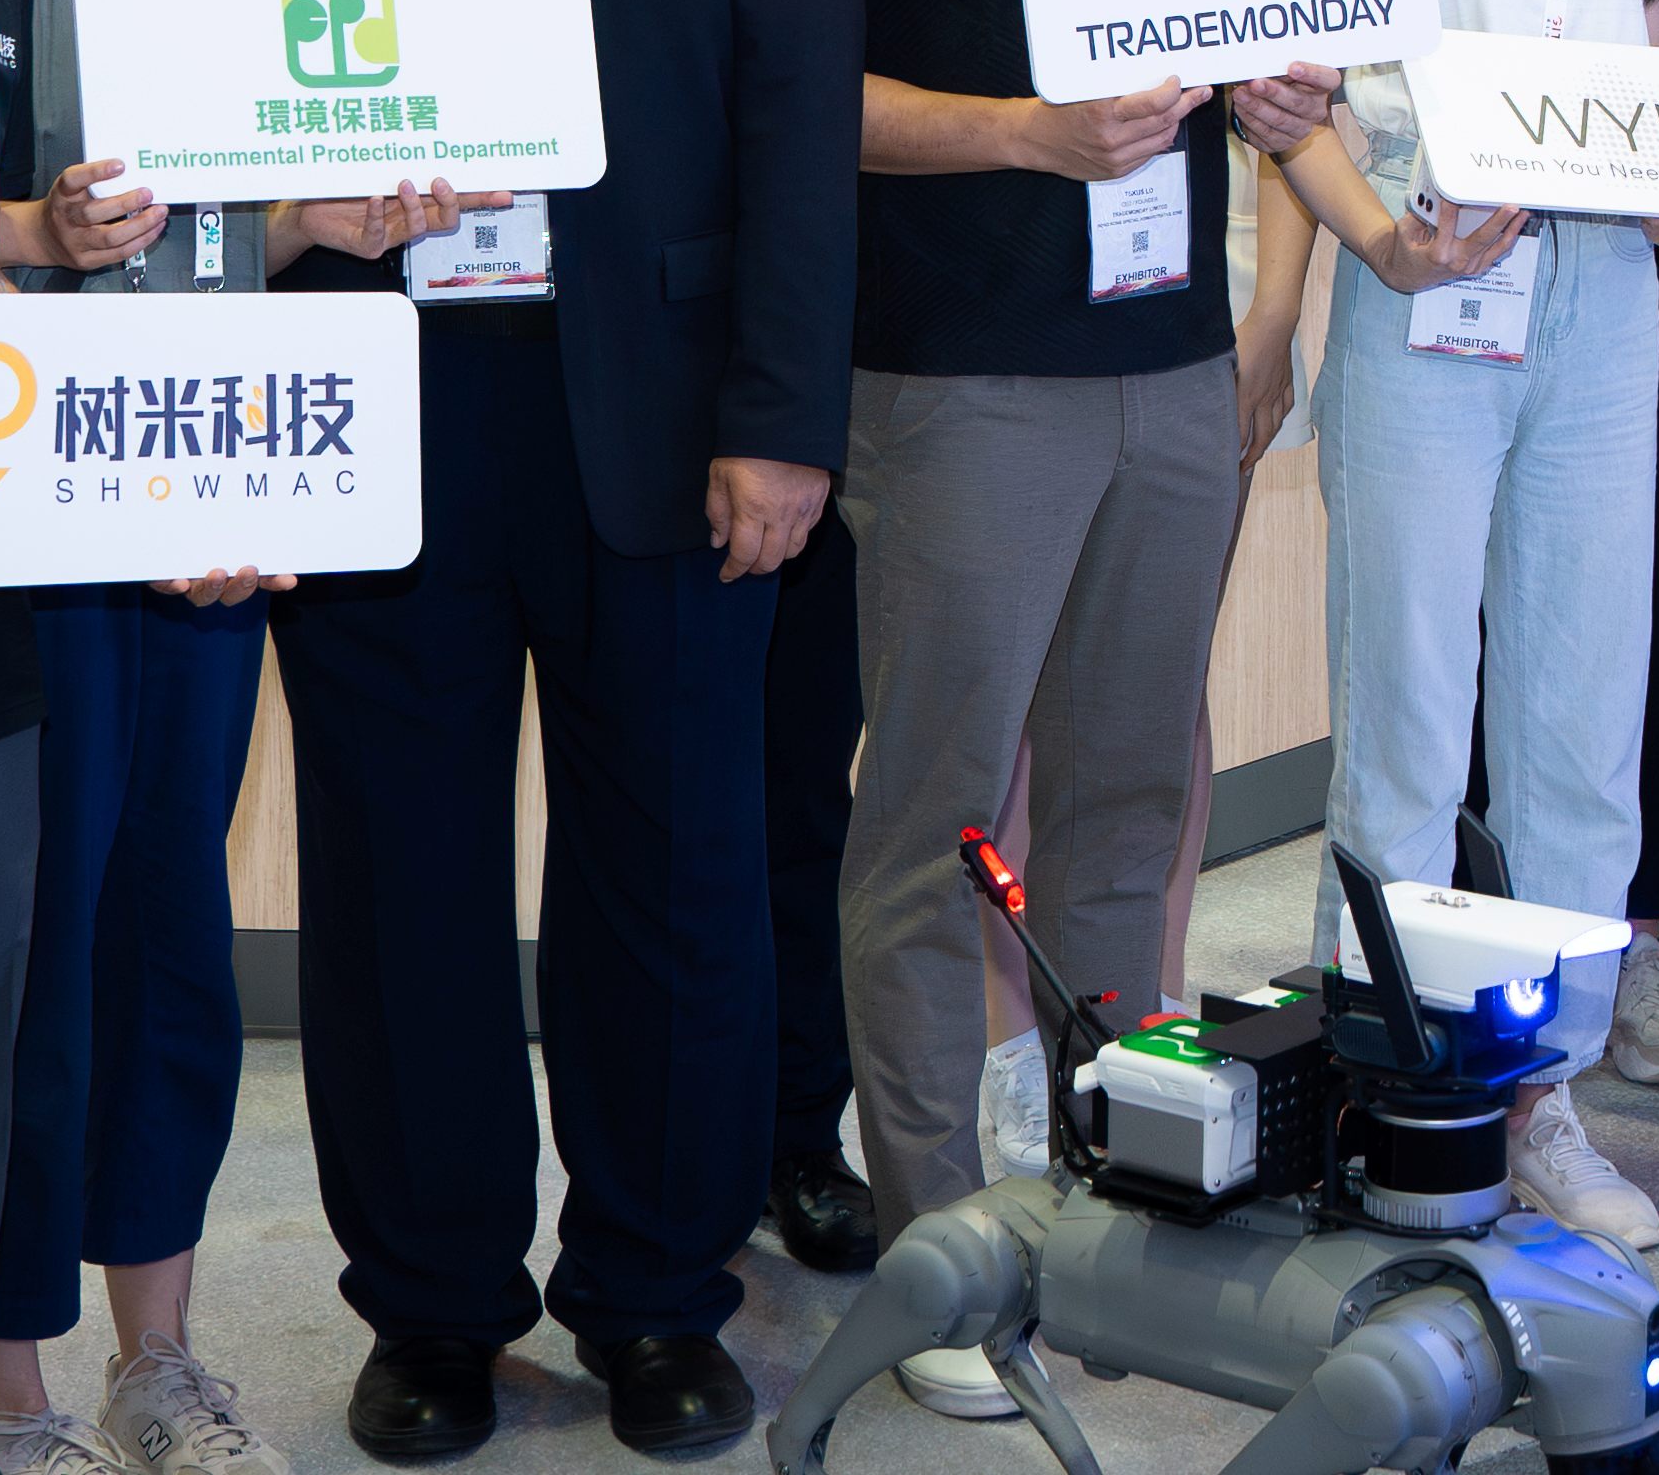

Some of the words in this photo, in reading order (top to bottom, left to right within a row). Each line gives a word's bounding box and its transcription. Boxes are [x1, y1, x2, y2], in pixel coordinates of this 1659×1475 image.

[256, 97, 438, 135] 環境保護署
[138, 147, 303, 169] Environmental
[313, 144, 425, 164] Protection
[434, 139, 558, 163] Department
[1478, 155, 1543, 171] When
[1561, 161, 1599, 176] You
[455, 262, 521, 274] EXHIBITOR
[1115, 266, 1168, 285] EXHIBITOR
[1436, 334, 1499, 351] EXHIBITOR
[55, 374, 353, 463] 树米科技
[56, 471, 354, 504] SHOWMAC
